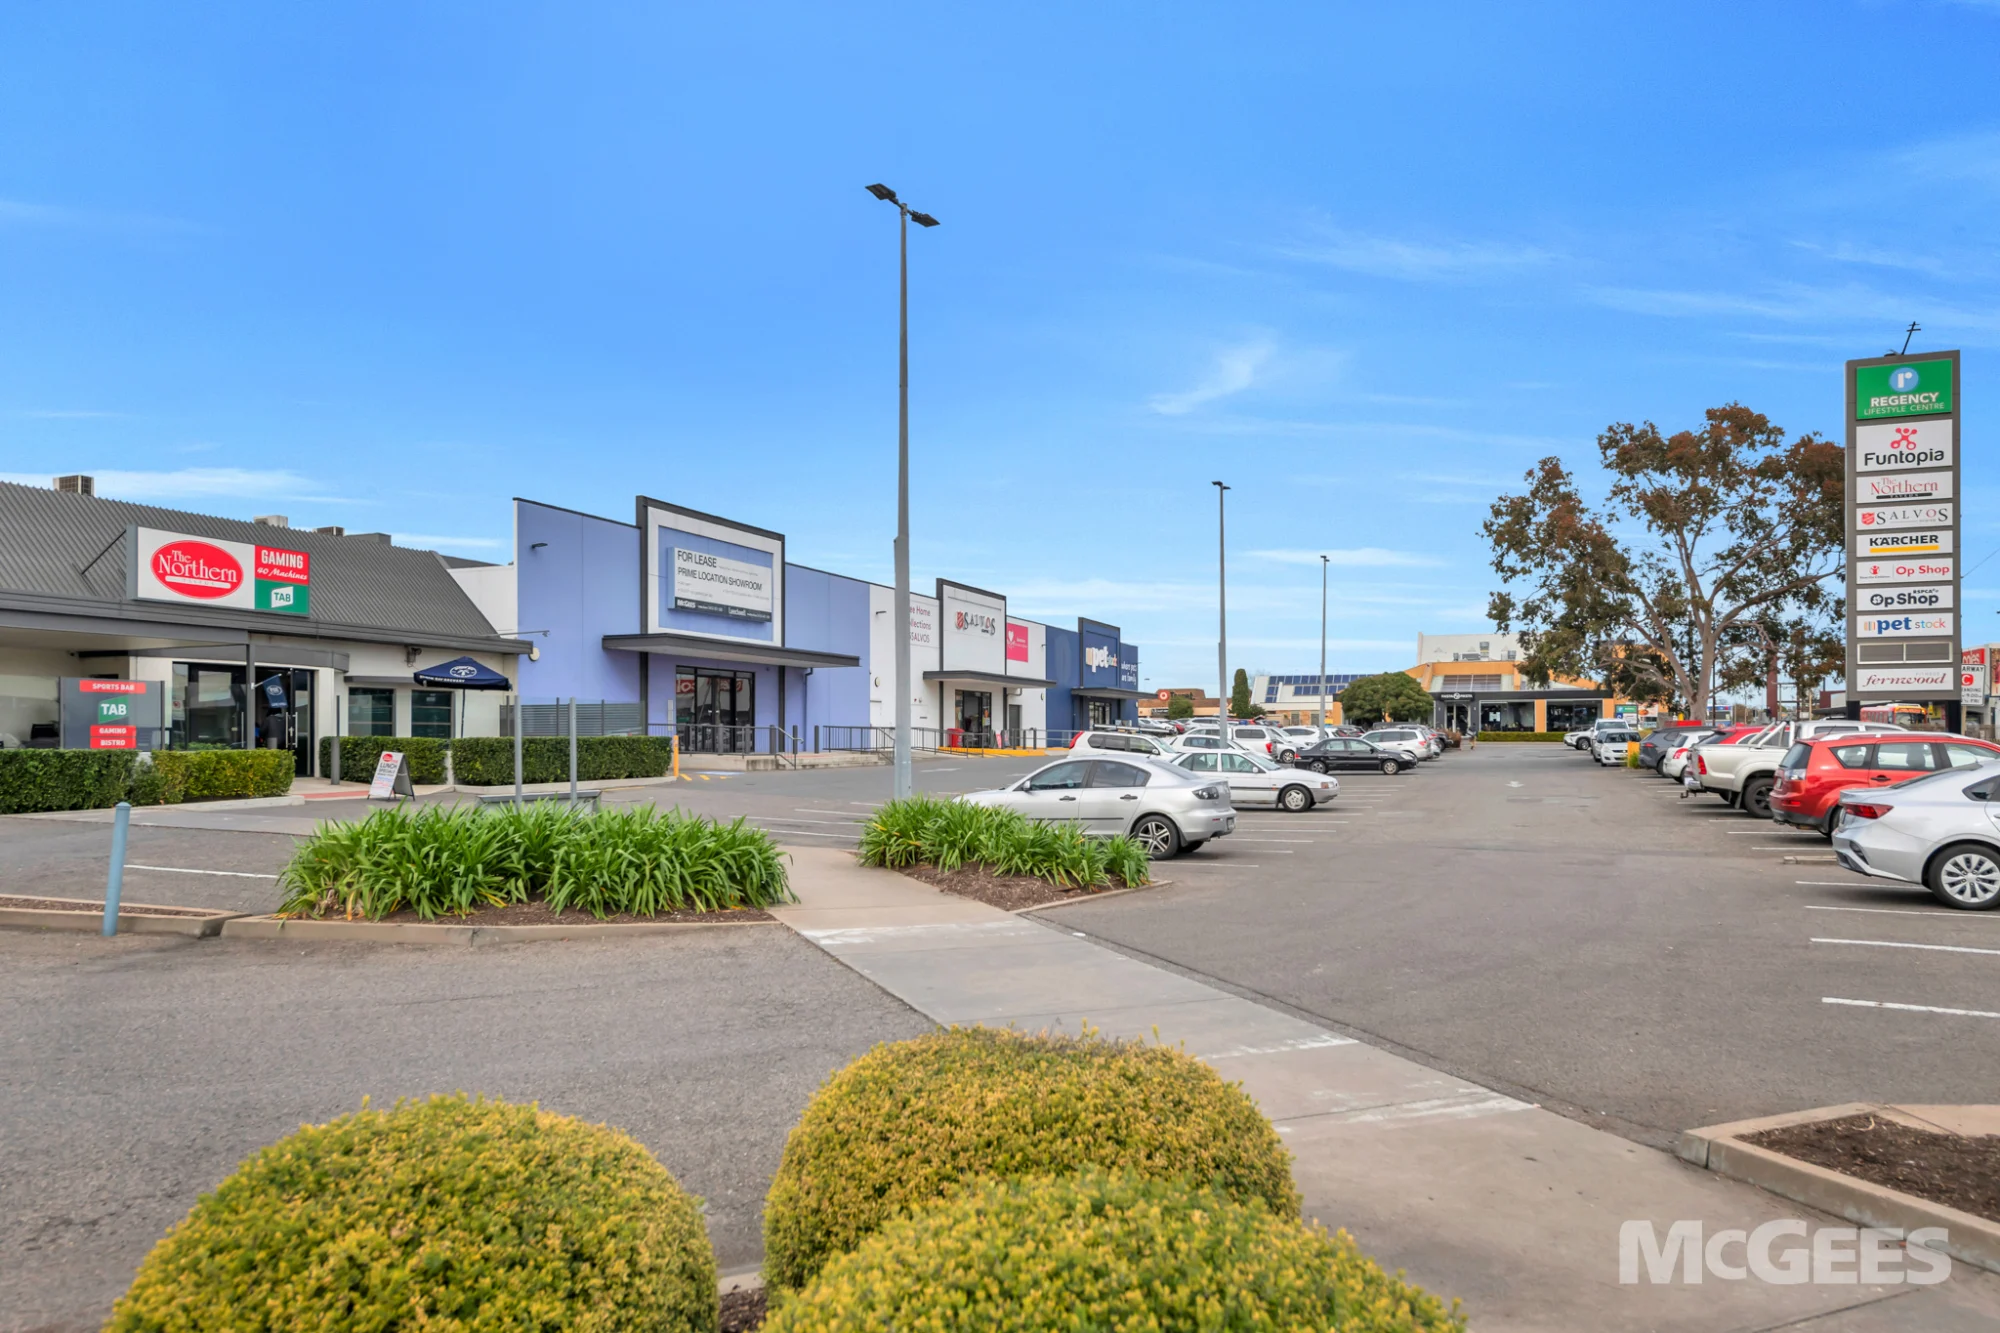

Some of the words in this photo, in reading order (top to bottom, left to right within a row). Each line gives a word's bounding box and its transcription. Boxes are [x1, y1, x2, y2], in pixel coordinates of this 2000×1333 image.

[1869, 392, 1940, 408] REGENCY
[1864, 405, 1906, 416] LIFESTYLE
[1909, 402, 1945, 412] CENTRE
[1864, 448, 1945, 466] Funtopia
[1870, 480, 1938, 495] Northern
[1881, 477, 1896, 486] The
[1876, 508, 1949, 526] SALVOS
[1869, 534, 1939, 547] KÄRCHER
[172, 550, 192, 564] The
[261, 550, 304, 569] GAMING
[677, 550, 693, 563] FOR
[694, 553, 717, 568] LEASE
[158, 554, 238, 583] Northern
[257, 567, 268, 575] 40
[268, 567, 308, 581] Machines
[1895, 565, 1915, 577] Op
[1918, 565, 1950, 576] Shop
[677, 566, 697, 579] PRIME
[698, 571, 728, 586] LOCATION
[729, 578, 763, 591] SHOWROOM
[273, 592, 291, 602] TAB
[1870, 593, 1895, 608] Op
[1896, 592, 1939, 607] Shop
[916, 605, 931, 616] Home
[963, 611, 996, 636] SALVOS
[1877, 616, 1912, 635] pet
[1914, 617, 1946, 629] stock
[92, 683, 120, 691] SPORTS
[120, 683, 135, 691] BAR
[1862, 672, 1947, 688] fernwood
[1962, 674, 1972, 685] C
[100, 703, 127, 716] TAB
